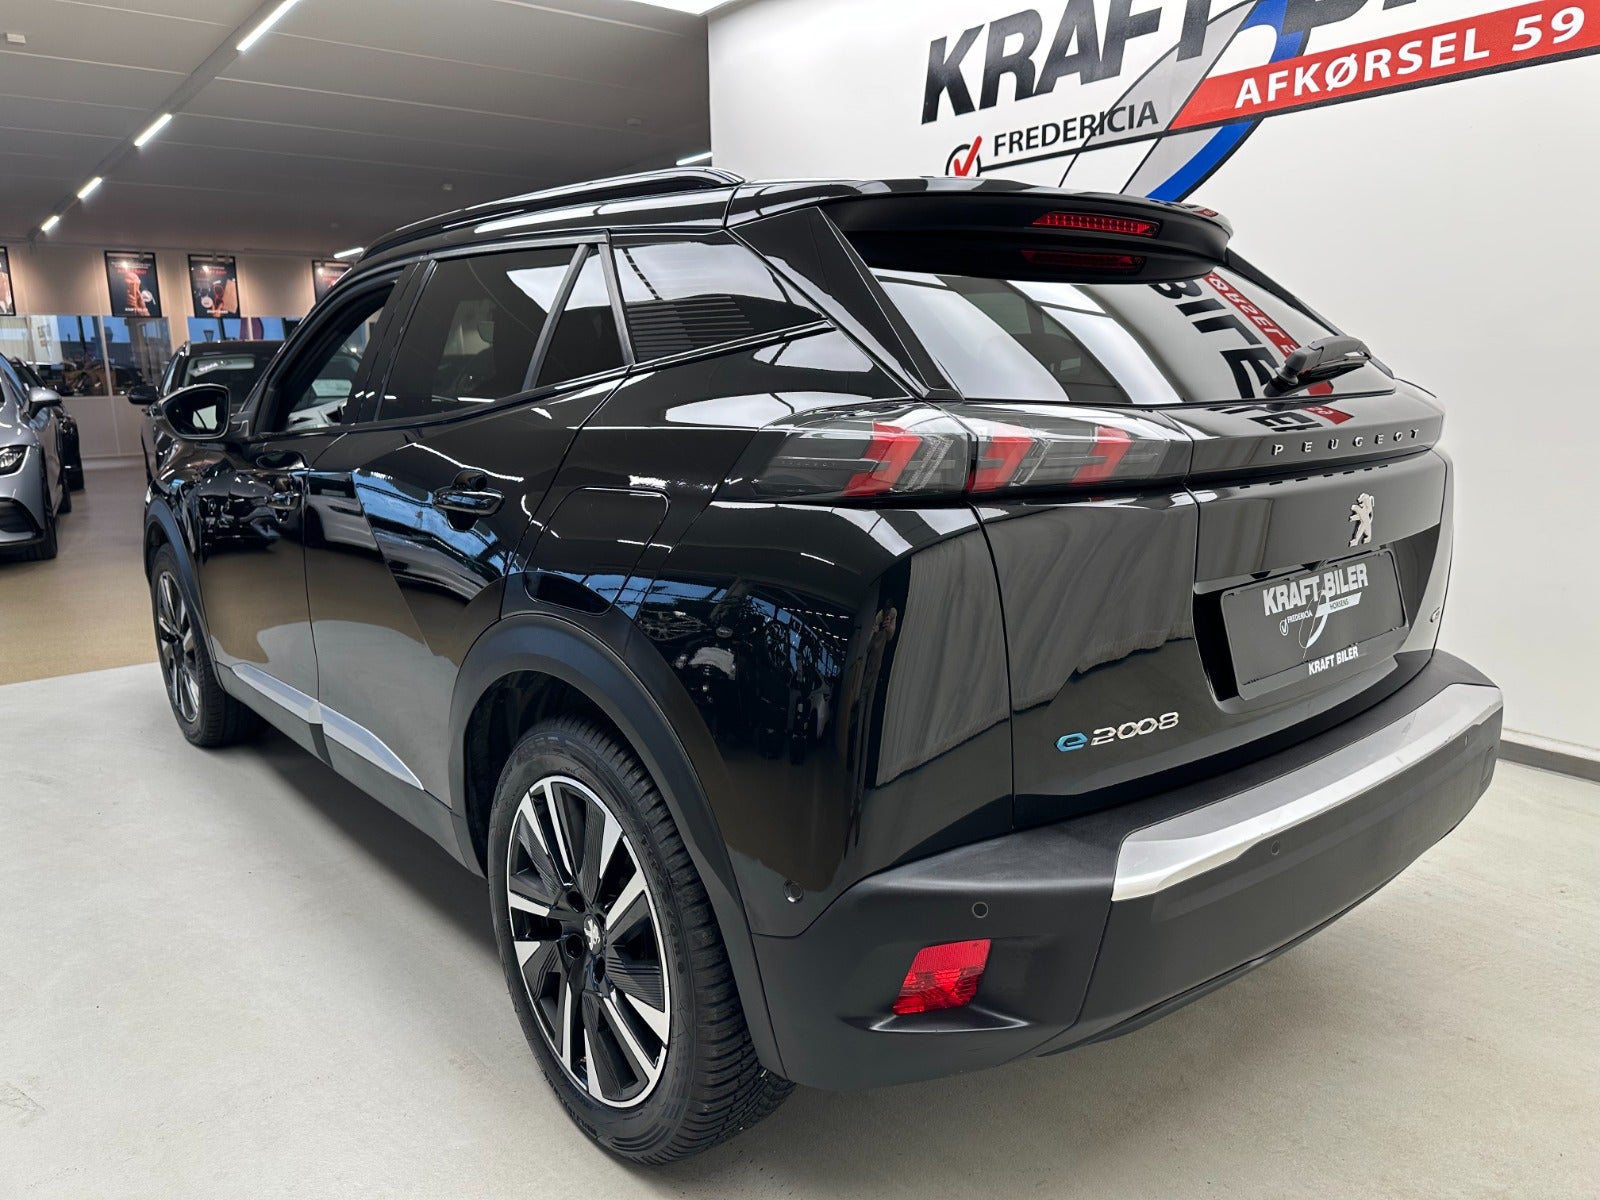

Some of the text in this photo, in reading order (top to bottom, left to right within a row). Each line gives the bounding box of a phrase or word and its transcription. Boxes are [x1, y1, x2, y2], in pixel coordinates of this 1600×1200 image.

[1233, 6, 1586, 109] AFKØRSEL 59
[993, 100, 1159, 157] FREDERICIA
[1272, 428, 1420, 456] PEUGEOT
[1262, 563, 1369, 616] KRAFT BILER
[1308, 645, 1359, 676] KRAFT BILER
